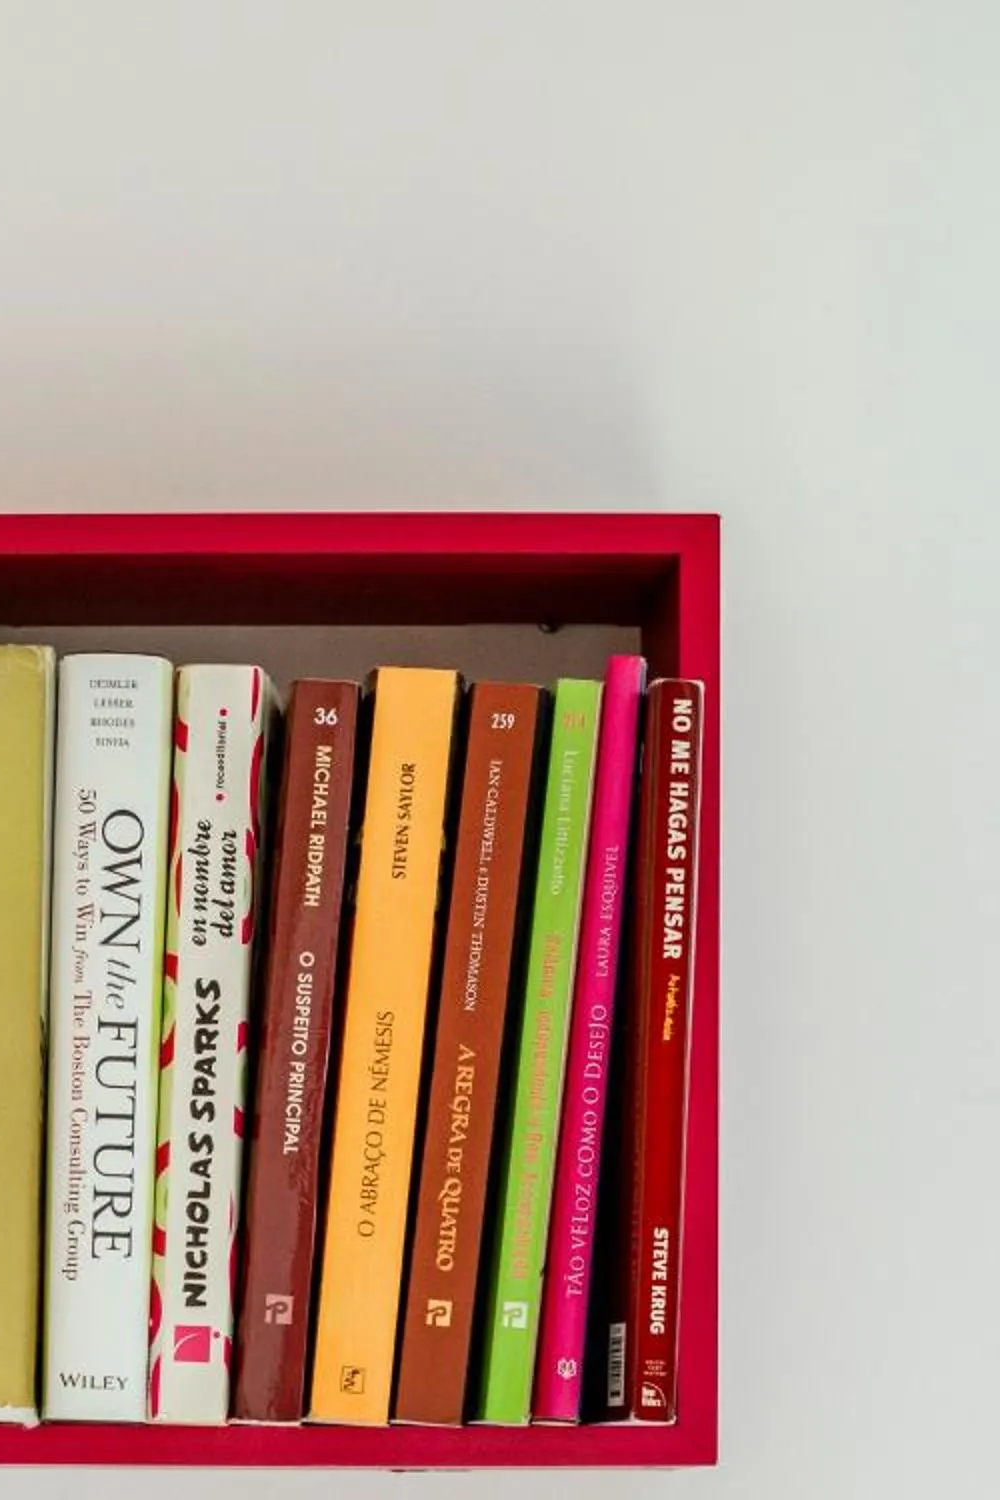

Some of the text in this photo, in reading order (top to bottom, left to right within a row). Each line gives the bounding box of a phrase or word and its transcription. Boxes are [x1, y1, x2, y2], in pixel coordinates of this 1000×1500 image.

[313, 707, 338, 726] 36
[490, 713, 515, 730] 259
[670, 739, 691, 775] ME
[671, 698, 693, 733] NO
[303, 745, 332, 907] MICHAEL RIDPATH
[391, 762, 416, 880] STEVEN SAYLOR
[480, 788, 499, 865] CALDWELL
[488, 760, 503, 787] IAN
[666, 782, 689, 861] HAGAS
[187, 819, 212, 947] en nombre
[210, 829, 237, 938] del amor
[473, 875, 490, 928] DUSTIN
[596, 845, 620, 977] LAURA ESQUIVEL
[662, 867, 686, 960] PENSAR
[464, 931, 483, 1012] THOMASON
[60, 788, 97, 1282] 50 Ways to Win from The Boston Consulting Group
[90, 809, 145, 1259] OWN the FUTURE
[283, 951, 316, 1155] O SUSPEITO PRINCIPAL
[182, 977, 222, 1308] NICHOLAS SPARKS
[357, 1010, 395, 1238] O ABRAÇO DE NÉMESIS
[435, 1043, 477, 1272] A REGRA DE QUATRO
[563, 1004, 609, 1296] TÃO VELOZ COMO O DESEJO
[649, 1227, 669, 1335] STEVE KRUG
[58, 1372, 129, 1391] WILEY
